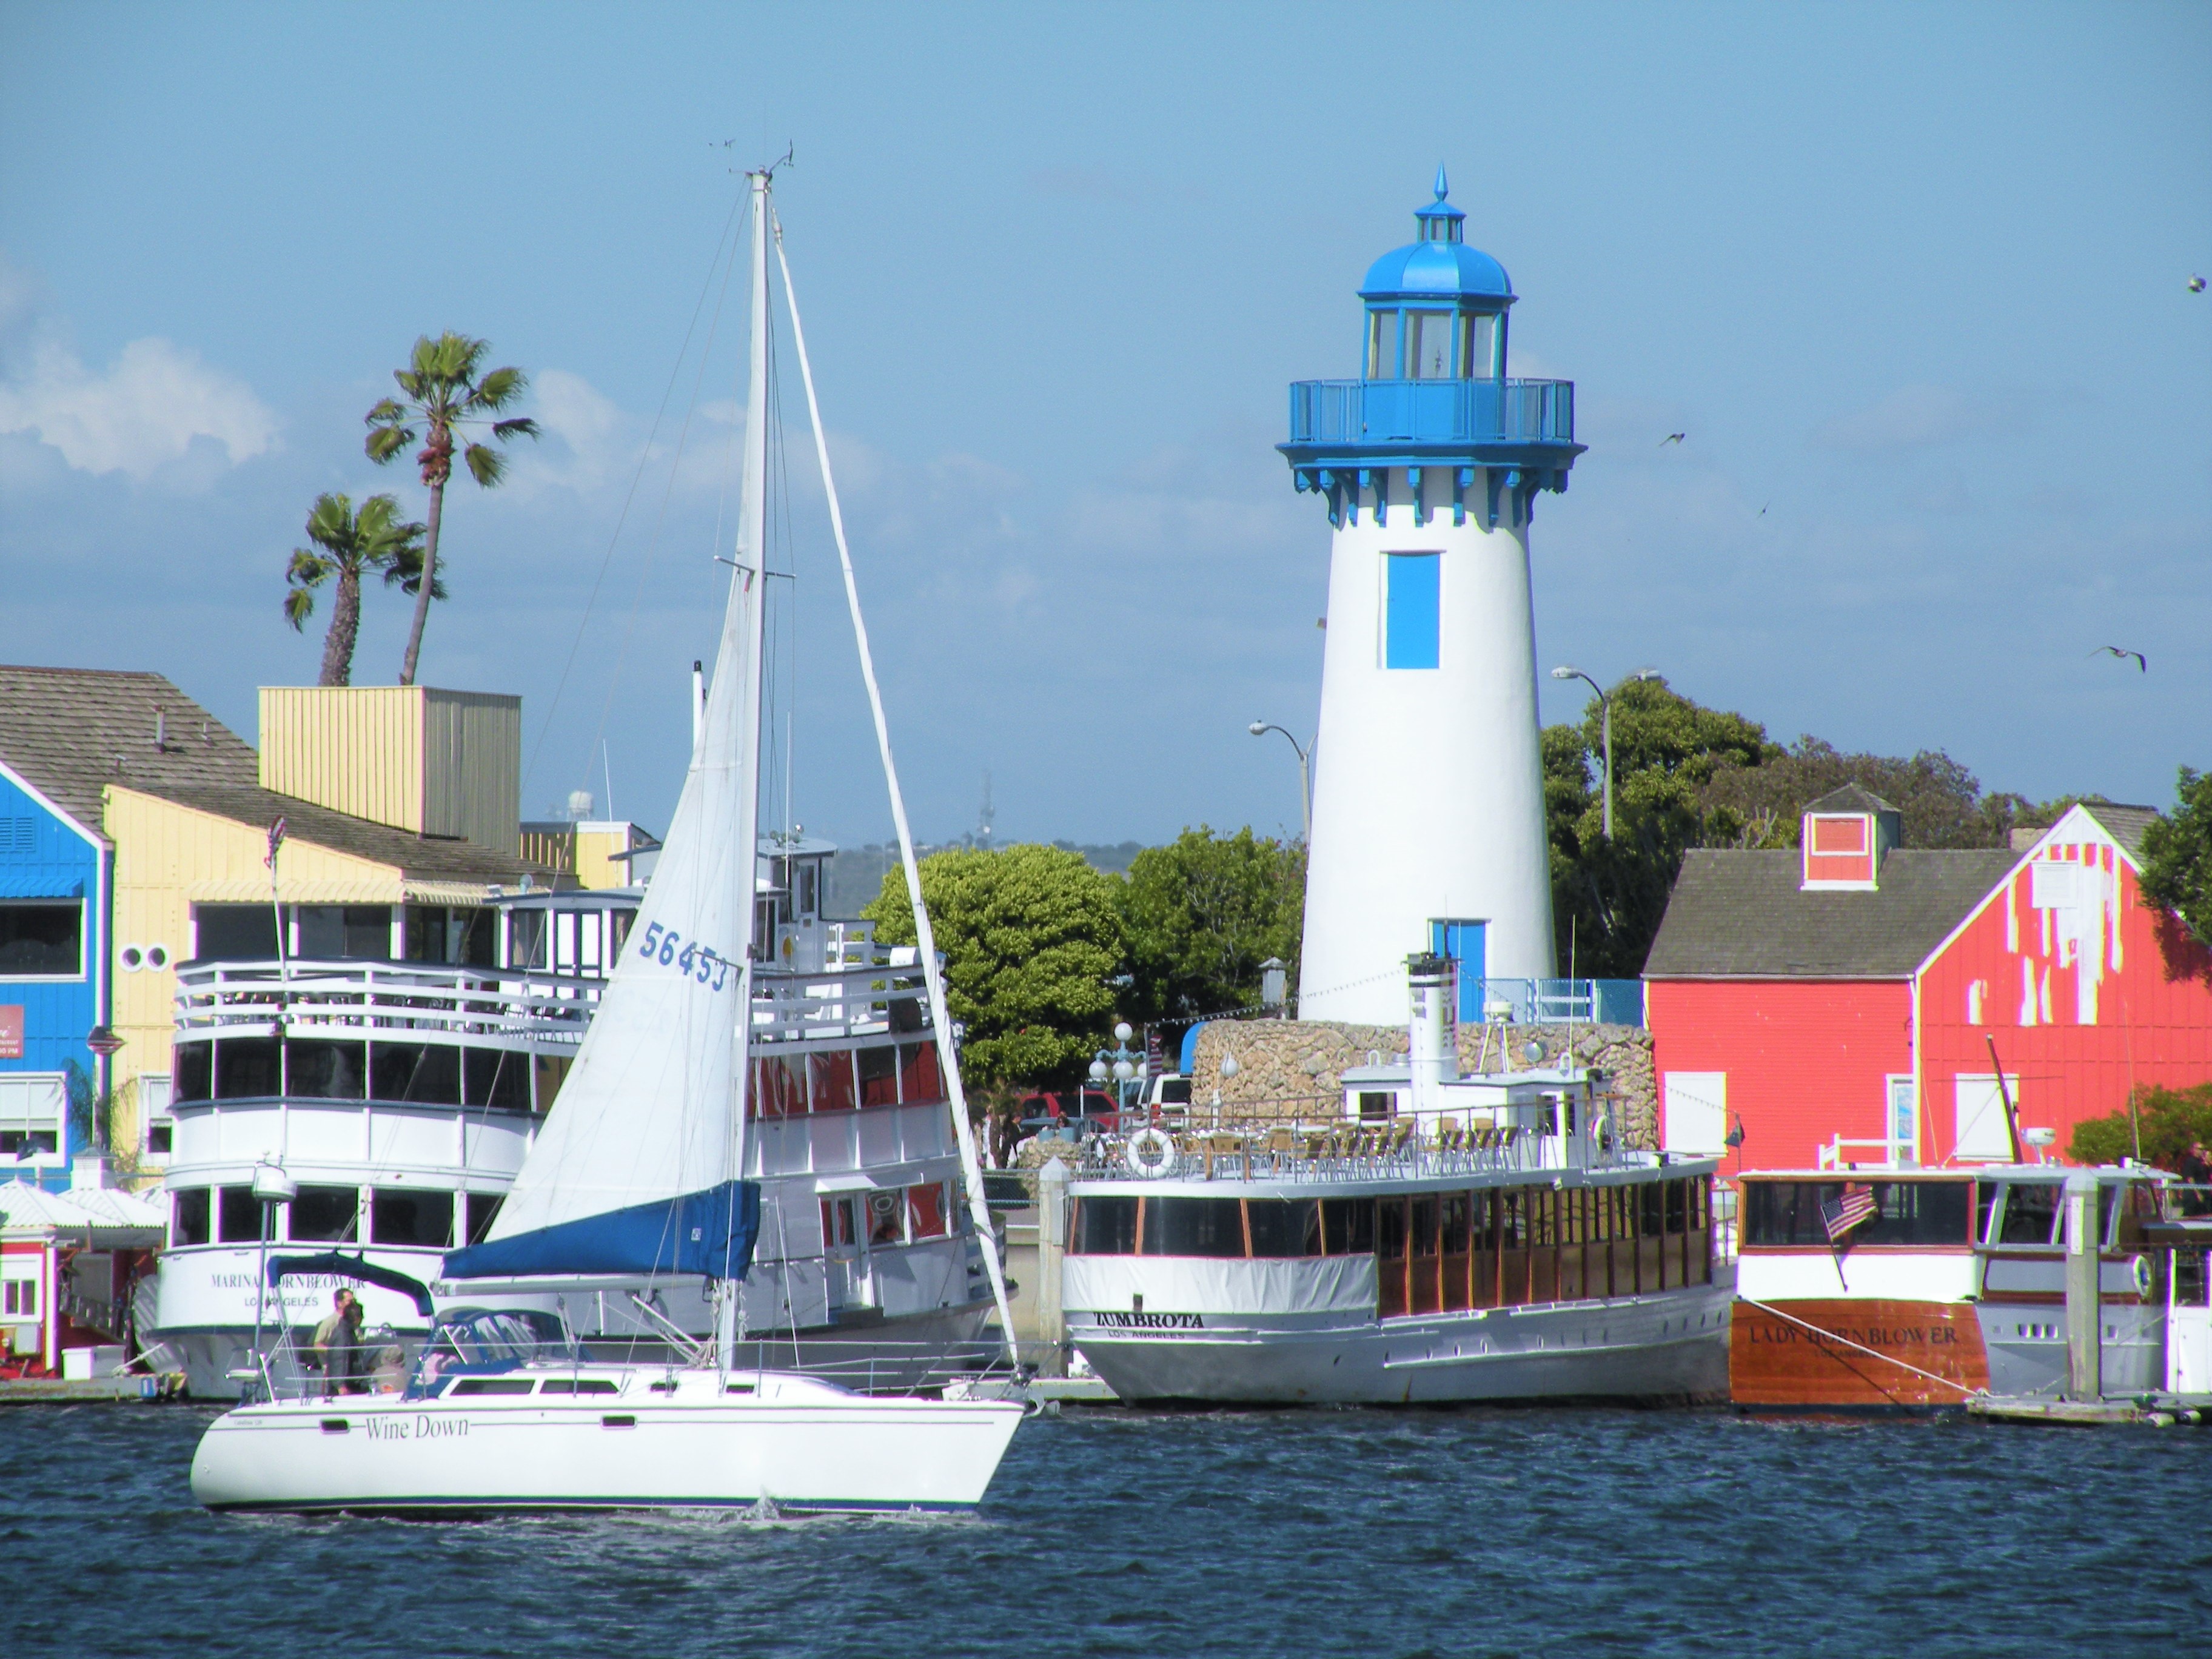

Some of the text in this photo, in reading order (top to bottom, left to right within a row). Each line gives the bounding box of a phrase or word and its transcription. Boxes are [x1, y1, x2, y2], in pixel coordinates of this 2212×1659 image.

[640, 920, 727, 992] 56453
[211, 1273, 260, 1288] MARINA
[1093, 1312, 1204, 1329] ZUMBROTA
[1132, 1331, 1185, 1339] ANGELES
[1750, 1326, 1796, 1344] LADY
[366, 1415, 469, 1439] Wine Down
